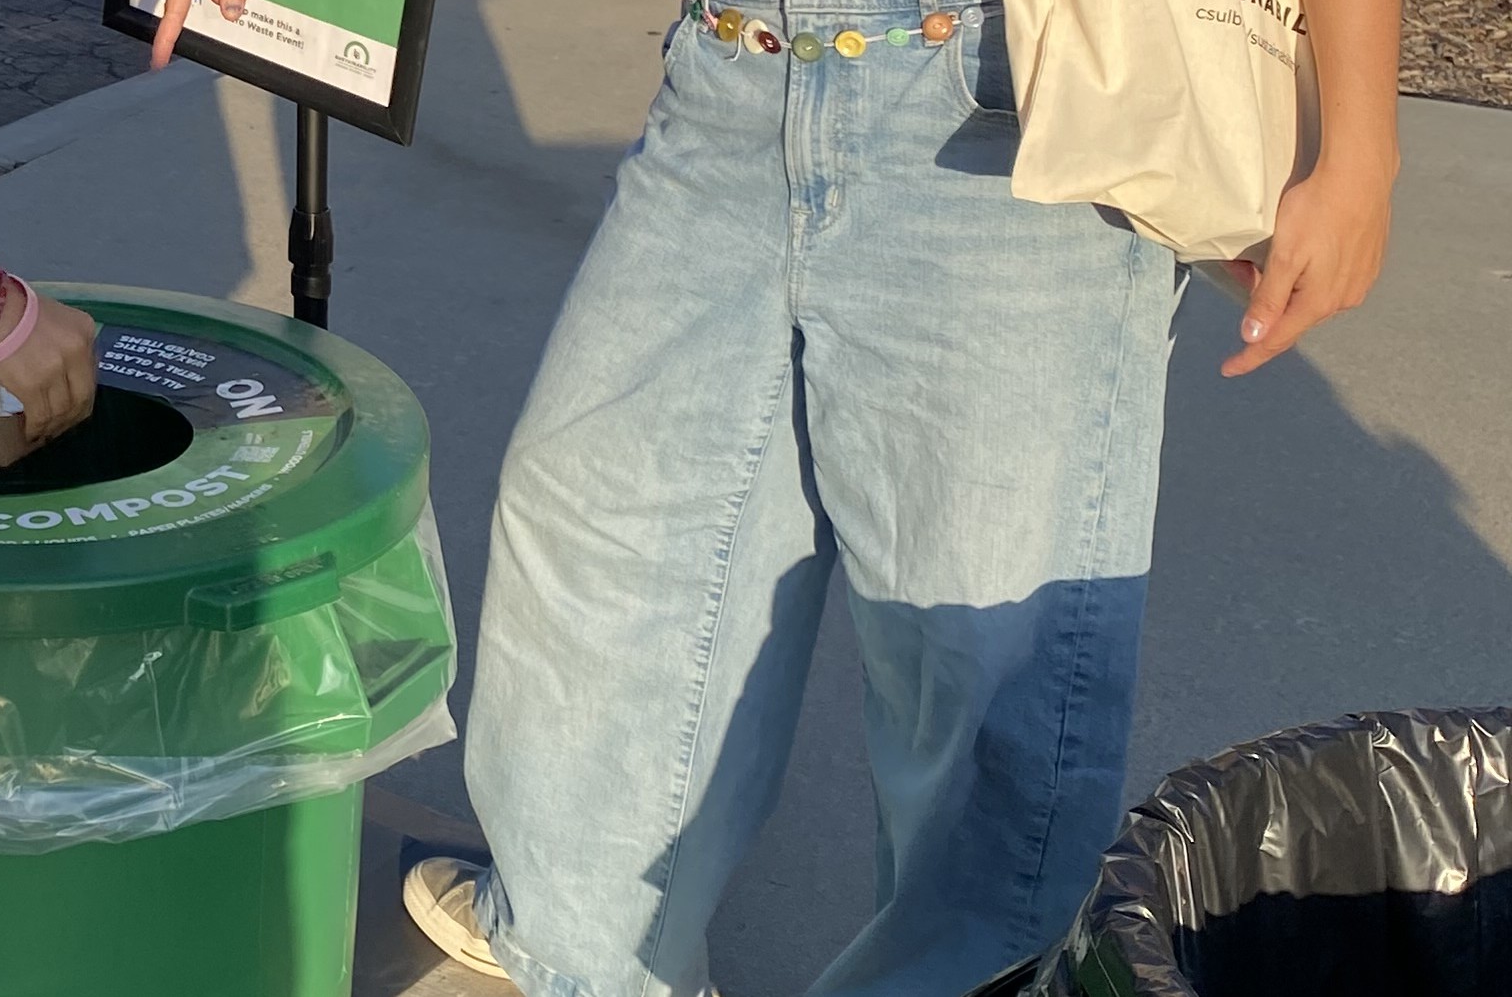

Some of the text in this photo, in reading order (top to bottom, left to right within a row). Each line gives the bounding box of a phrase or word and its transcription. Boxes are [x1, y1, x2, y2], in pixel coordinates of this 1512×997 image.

[247, 20, 274, 38] Waste
[276, 31, 304, 49] Event!
[251, 11, 274, 25] make
[277, 20, 293, 32] this
[295, 28, 300, 36] a
[104, 351, 153, 366] GLASS
[113, 342, 208, 368] WAX/PLASTIC
[119, 335, 216, 362] COATED ITEMS
[161, 378, 187, 390] ALL
[166, 364, 206, 382] METAL
[216, 379, 284, 419] NO
[128, 483, 273, 536] PAPER PLATES/NAPKINS
